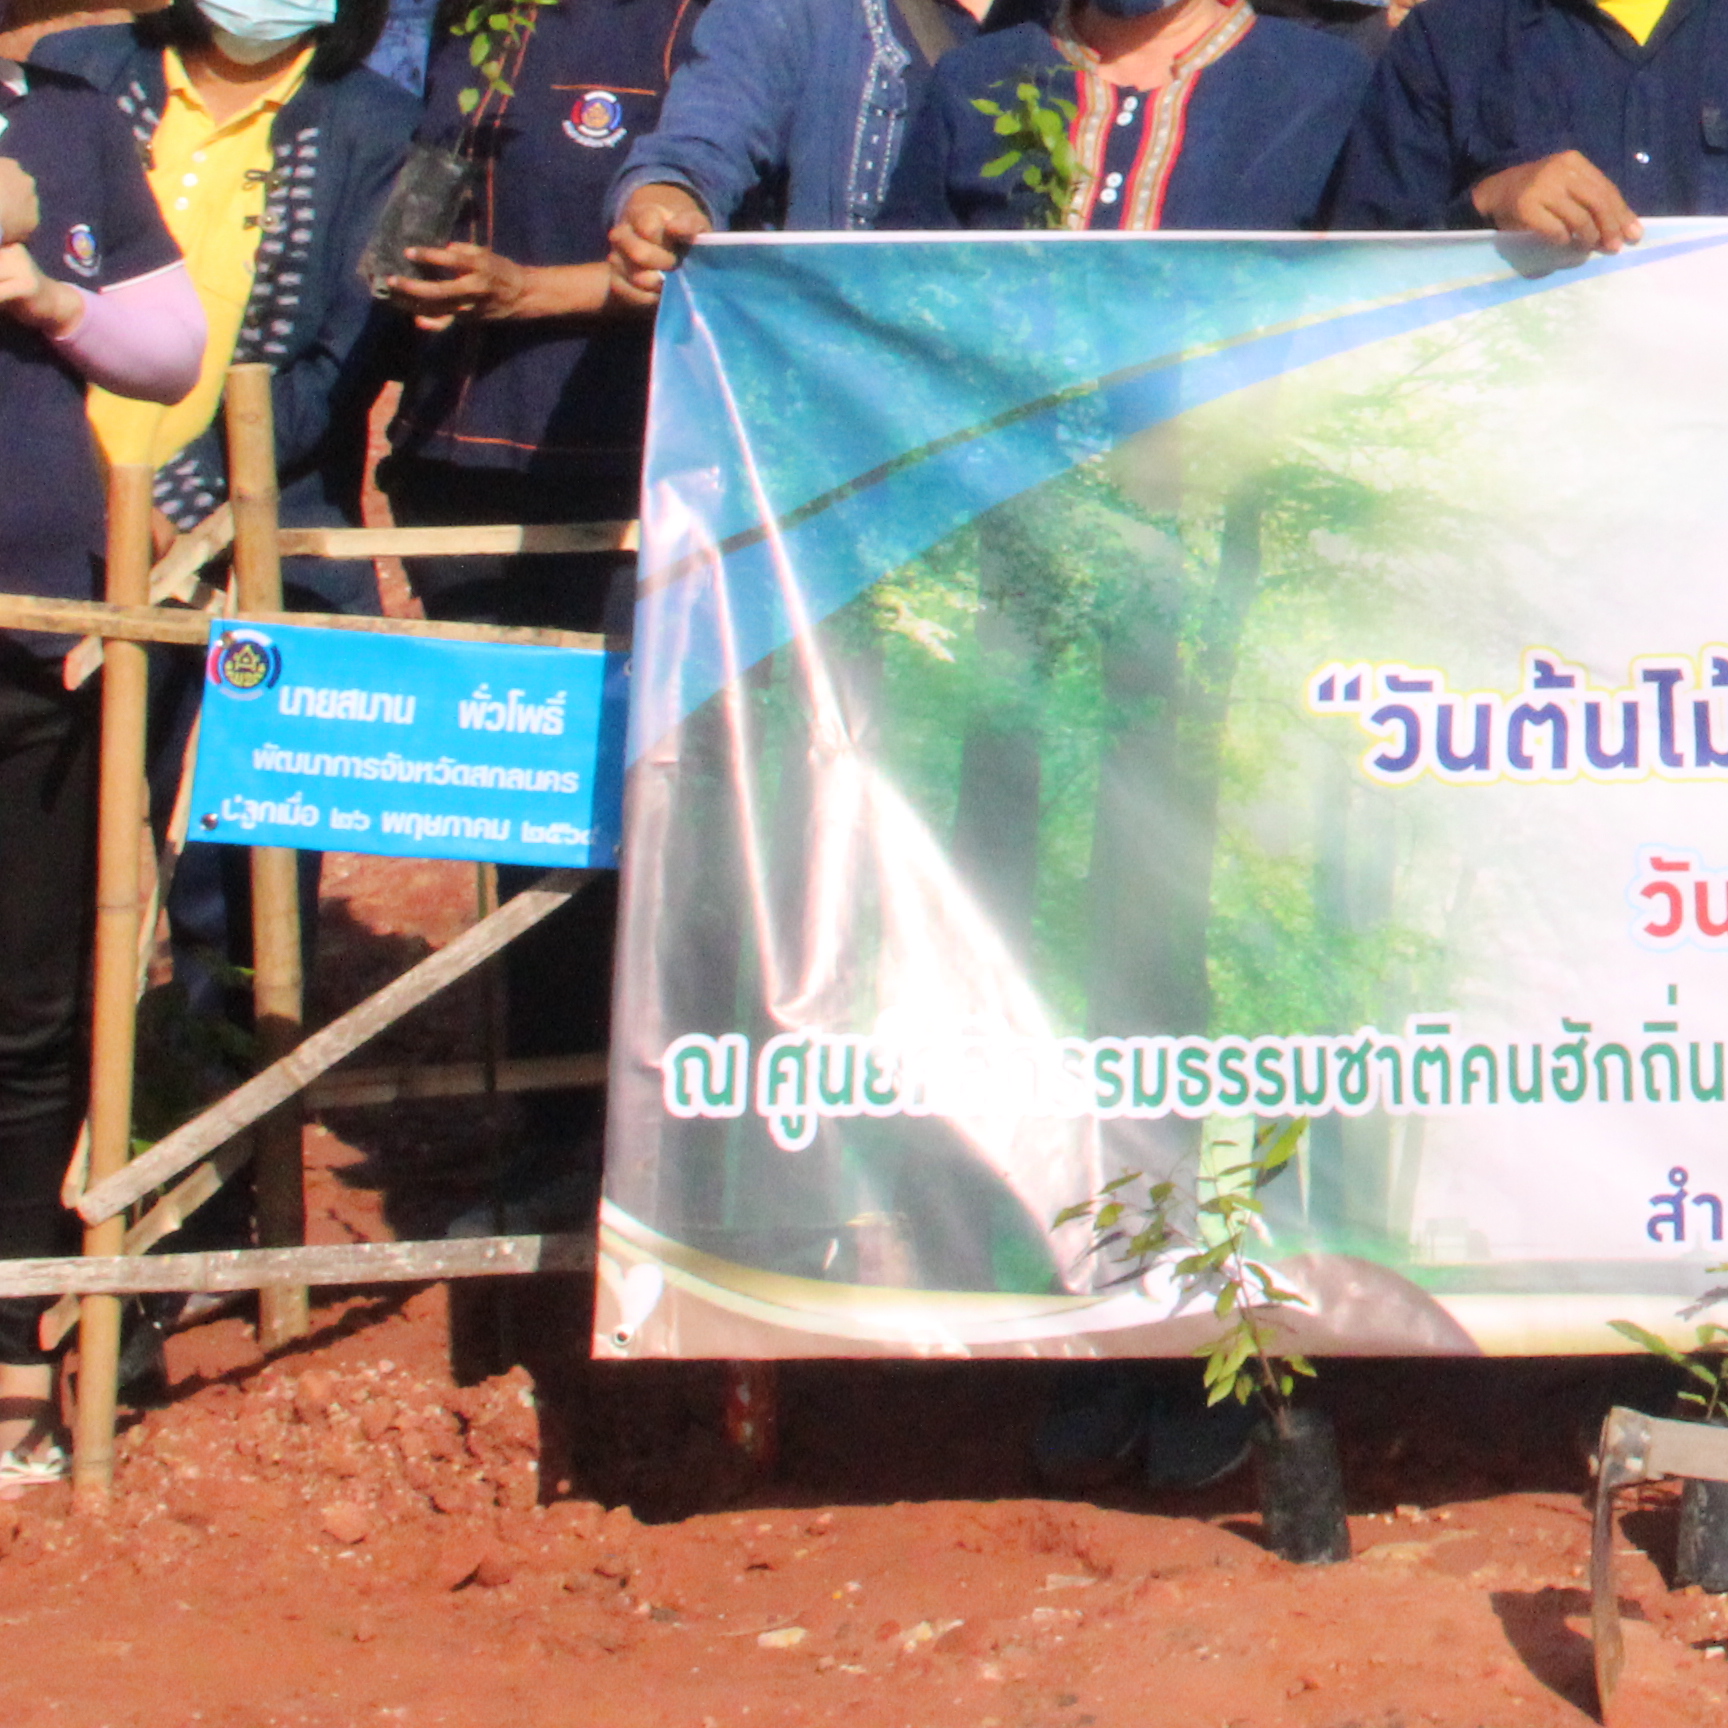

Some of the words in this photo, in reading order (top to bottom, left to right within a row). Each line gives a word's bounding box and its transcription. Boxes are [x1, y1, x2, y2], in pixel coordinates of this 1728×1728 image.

[279, 685, 416, 725] นายสมาน
[252, 743, 580, 794] พัฒนาการจังหวัดสกลนคร
[380, 811, 511, 841] พฤษภาคม
[673, 1044, 736, 1107] ณ
